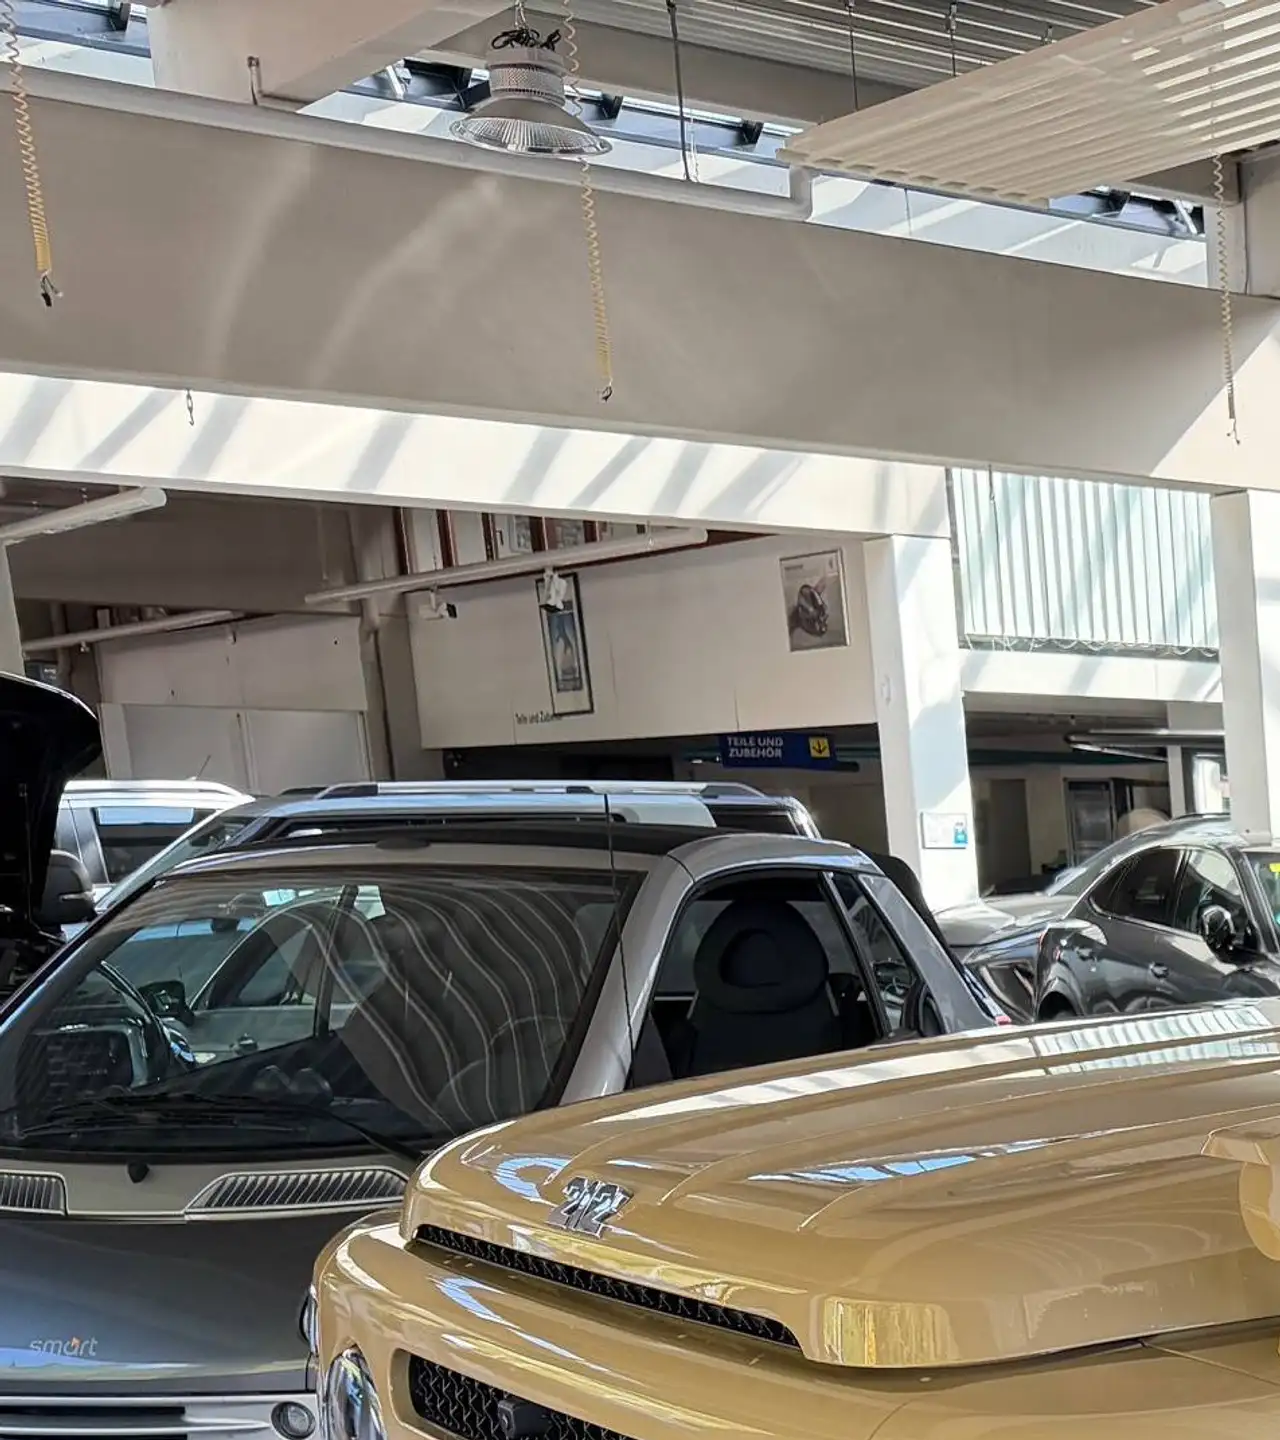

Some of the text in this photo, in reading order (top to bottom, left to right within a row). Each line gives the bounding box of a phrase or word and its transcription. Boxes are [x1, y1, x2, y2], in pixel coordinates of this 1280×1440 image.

[727, 736, 784, 747] TEILE UND
[728, 745, 782, 758] ZUBEHÖR
[556, 1175, 633, 1232] 212
[29, 1336, 98, 1357] smart
